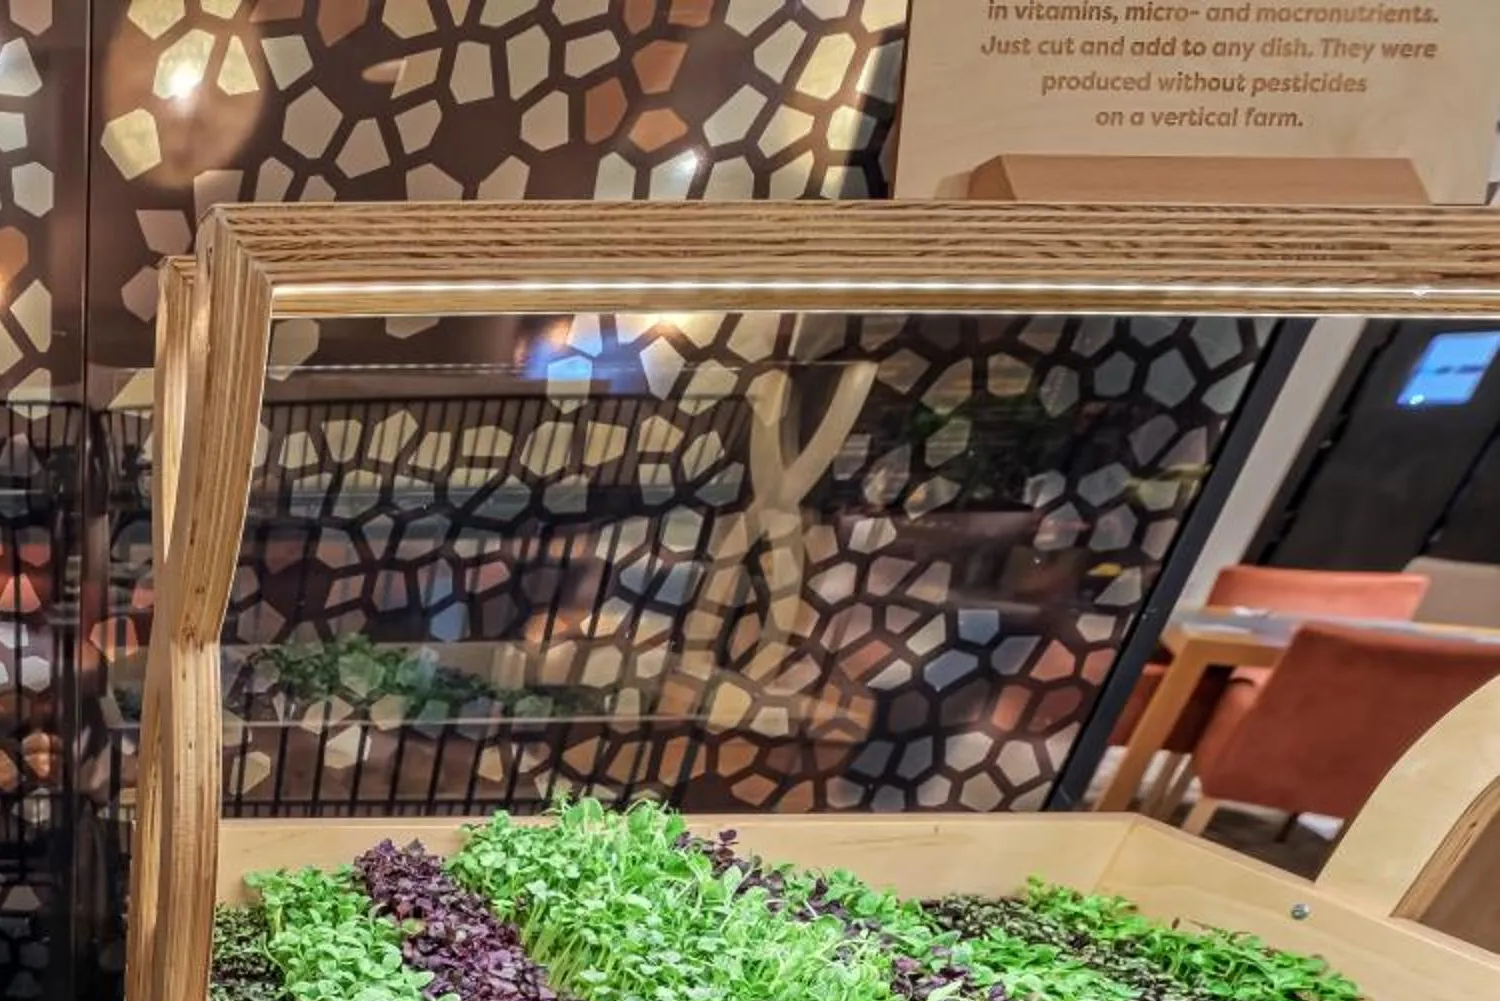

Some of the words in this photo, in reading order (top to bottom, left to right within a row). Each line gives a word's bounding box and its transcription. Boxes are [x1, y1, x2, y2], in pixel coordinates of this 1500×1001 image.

[987, 1, 1007, 21] in
[1014, 2, 1118, 24] vitamins,
[1124, 3, 1199, 22] micro-
[1205, 2, 1251, 23] and
[1255, 5, 1439, 24] macronutrients.
[980, 36, 1032, 56] Just
[1037, 38, 1075, 56] cut
[1080, 36, 1125, 56] and
[1129, 37, 1177, 57] add
[1182, 40, 1207, 57] to
[1212, 41, 1256, 62] any
[1260, 37, 1314, 58] dish.
[1320, 37, 1375, 63] They
[1381, 44, 1438, 59] were
[1041, 71, 1151, 96] produced
[1157, 71, 1246, 93] without
[1251, 72, 1368, 97] pesticides
[1095, 110, 1124, 126] on
[1130, 111, 1145, 126] a
[1151, 107, 1240, 128] vertical
[1244, 107, 1304, 127] farm.
